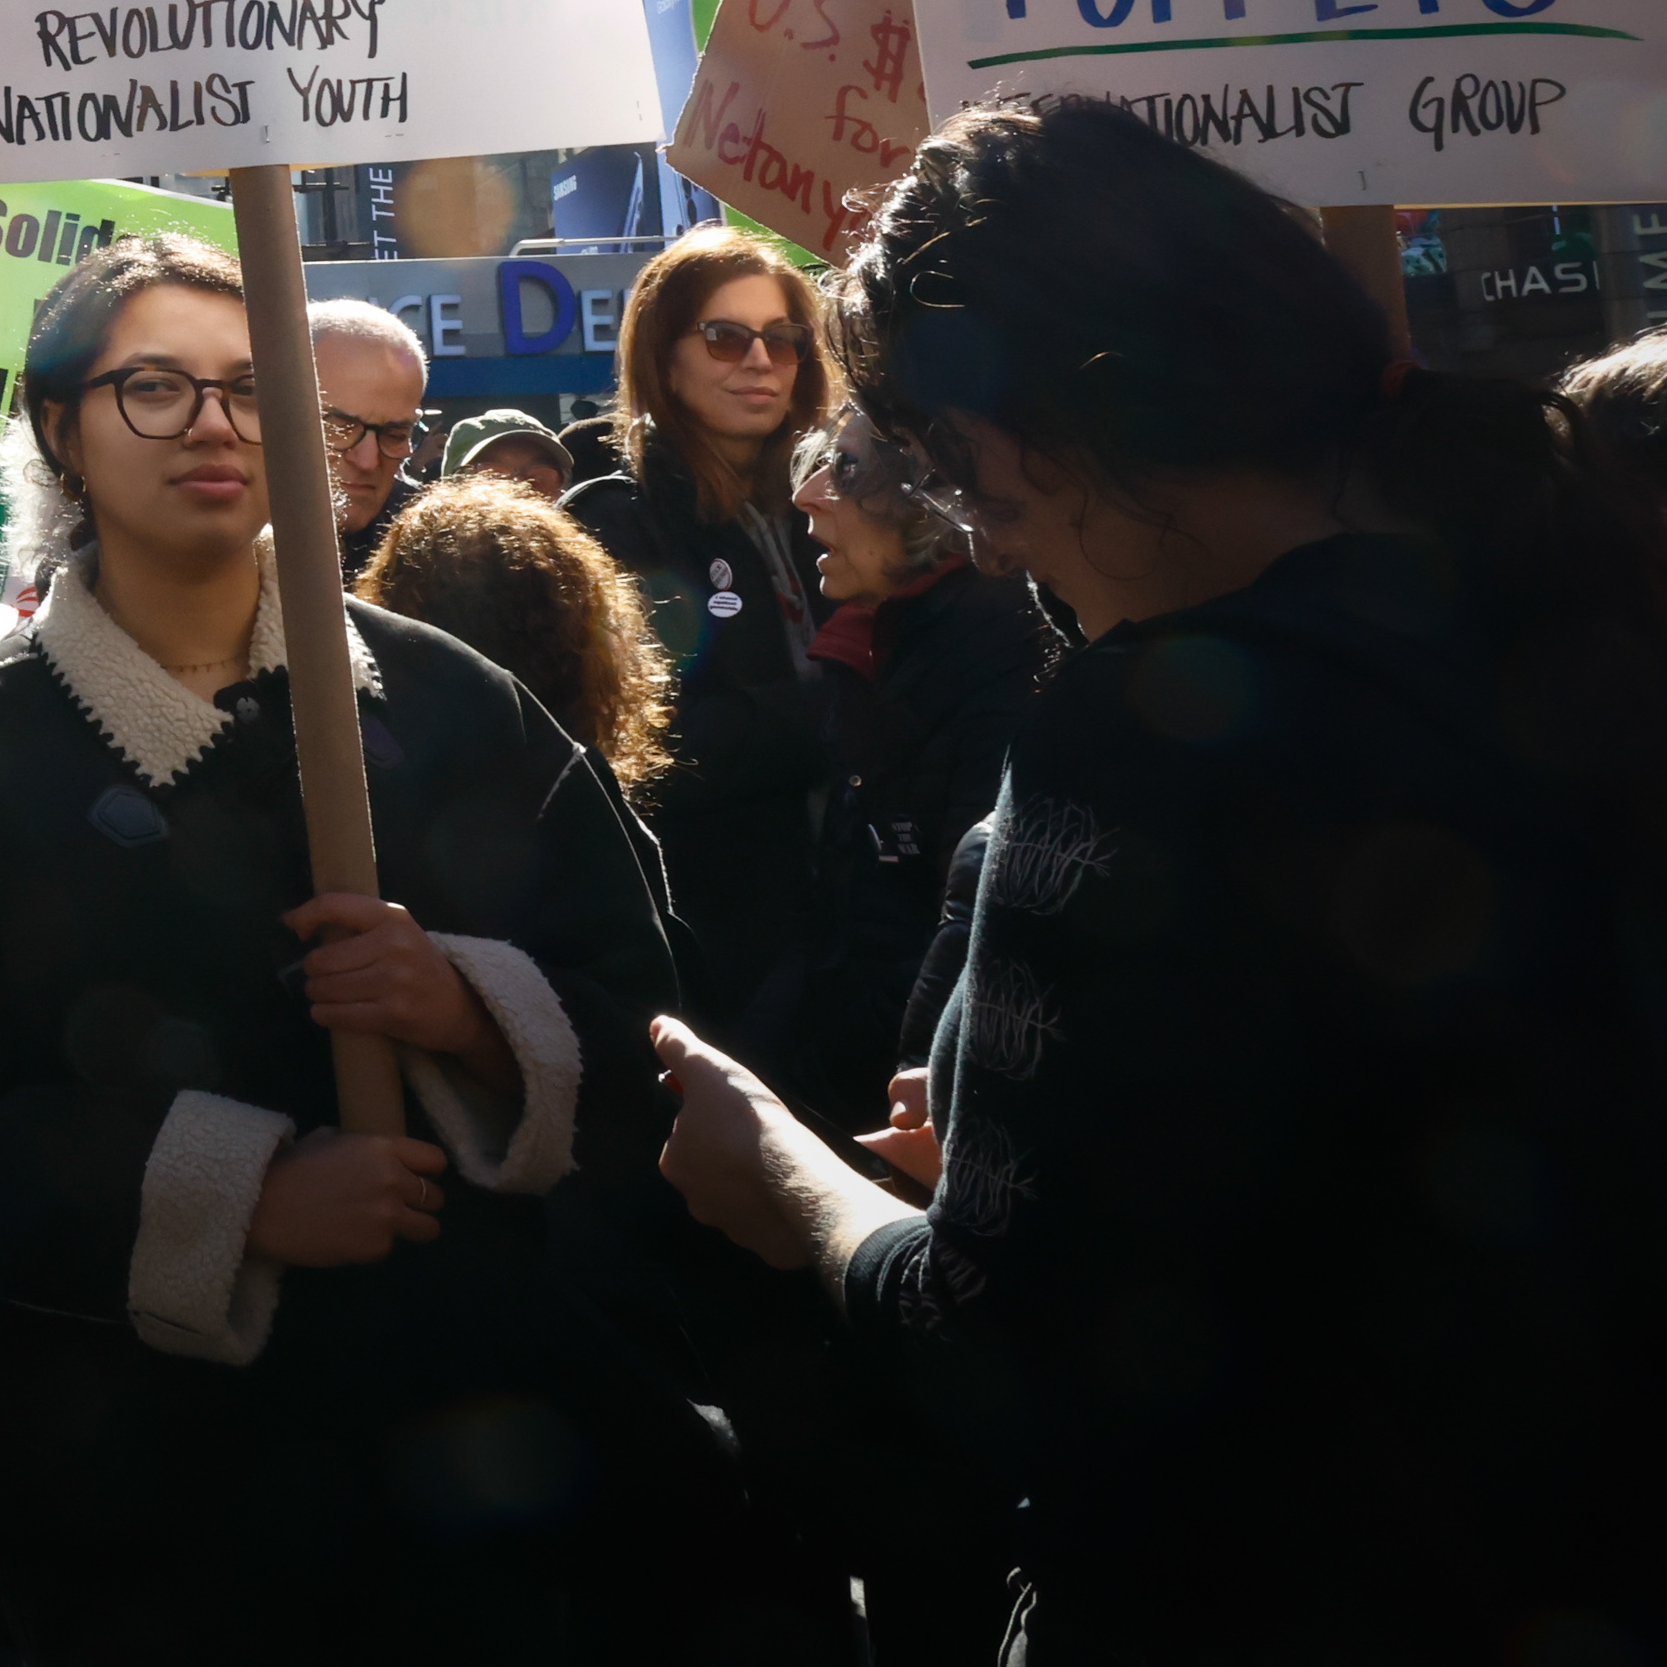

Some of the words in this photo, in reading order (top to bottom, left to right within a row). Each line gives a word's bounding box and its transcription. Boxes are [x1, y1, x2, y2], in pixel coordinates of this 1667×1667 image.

[285, 64, 409, 127] YOUTH
[825, 84, 911, 168] for
[1408, 73, 1567, 152] GROUP
[369, 167, 396, 221] THE
[553, 174, 578, 201] SAMSUNG
[499, 260, 630, 356] DE
[1480, 260, 1600, 302] CHAS
